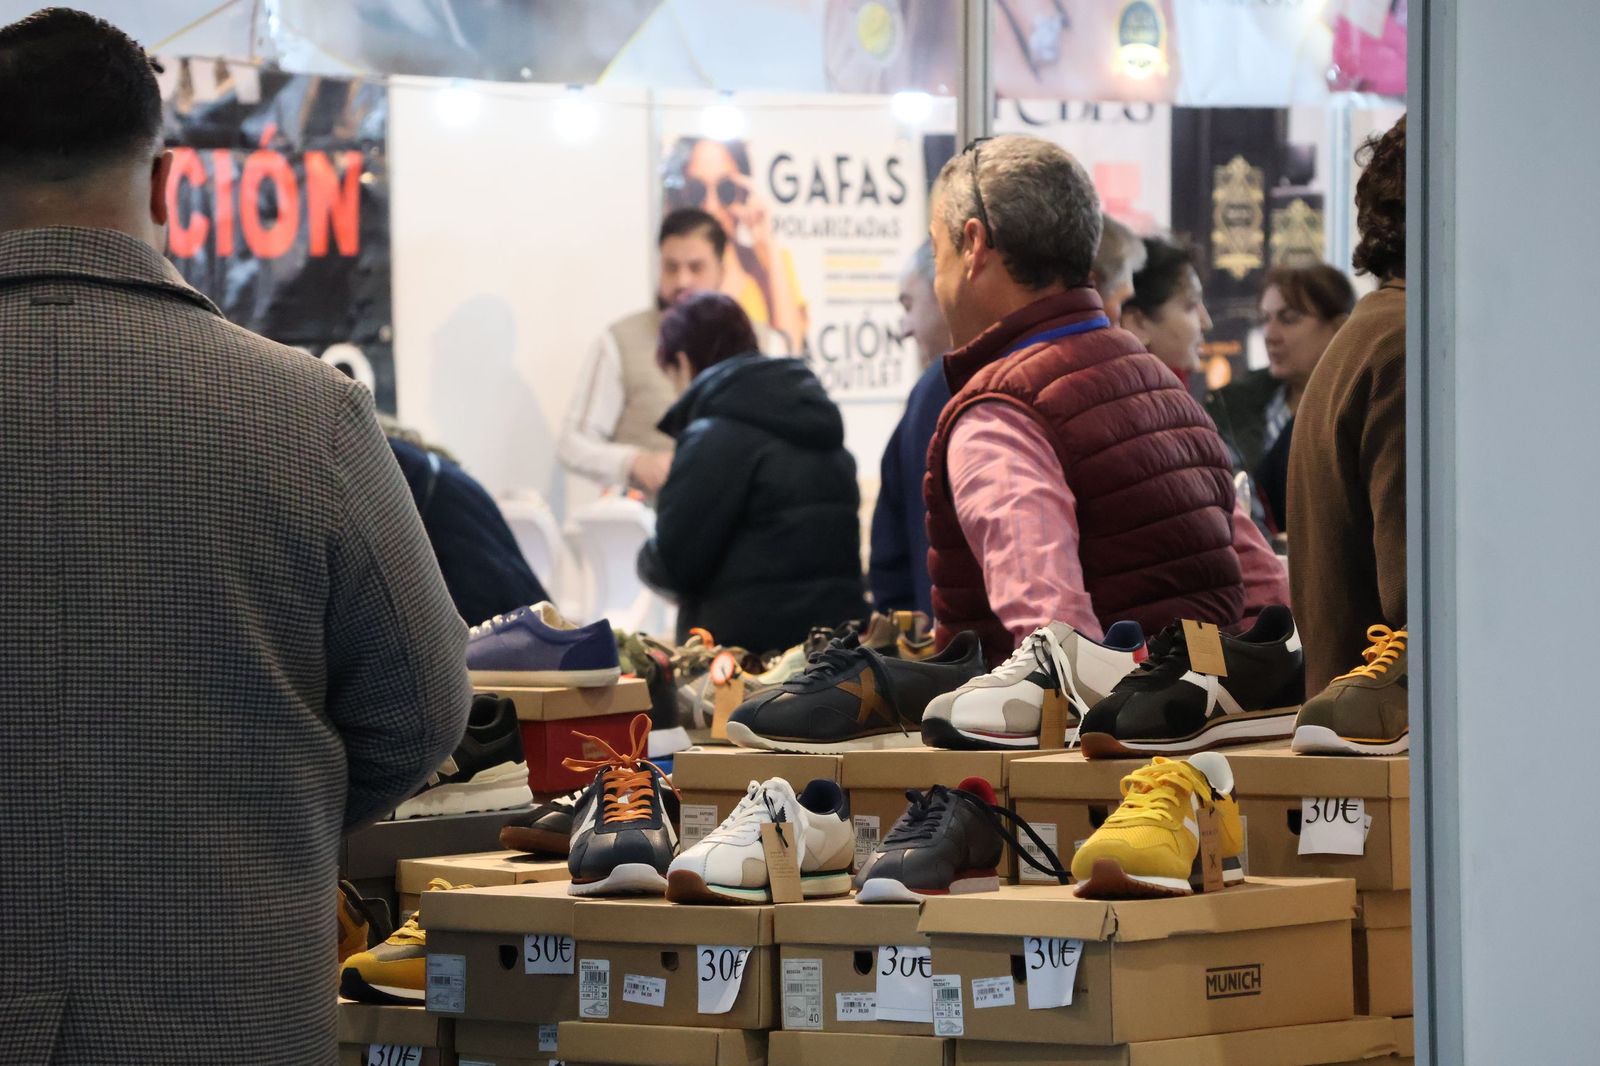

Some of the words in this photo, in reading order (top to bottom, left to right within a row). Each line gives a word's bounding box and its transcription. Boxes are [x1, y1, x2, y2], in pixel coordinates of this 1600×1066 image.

[769, 153, 906, 205] GAFAS
[772, 214, 903, 239] POLARIZADAS
[1305, 796, 1361, 824] 30€
[527, 934, 572, 963] 30€
[881, 945, 933, 978] 30€
[1030, 937, 1077, 970] 30€
[701, 949, 748, 982] 30€
[1206, 970, 1261, 994] MUNICH
[808, 1013, 819, 1024] 40
[371, 1045, 417, 1066] 30€
